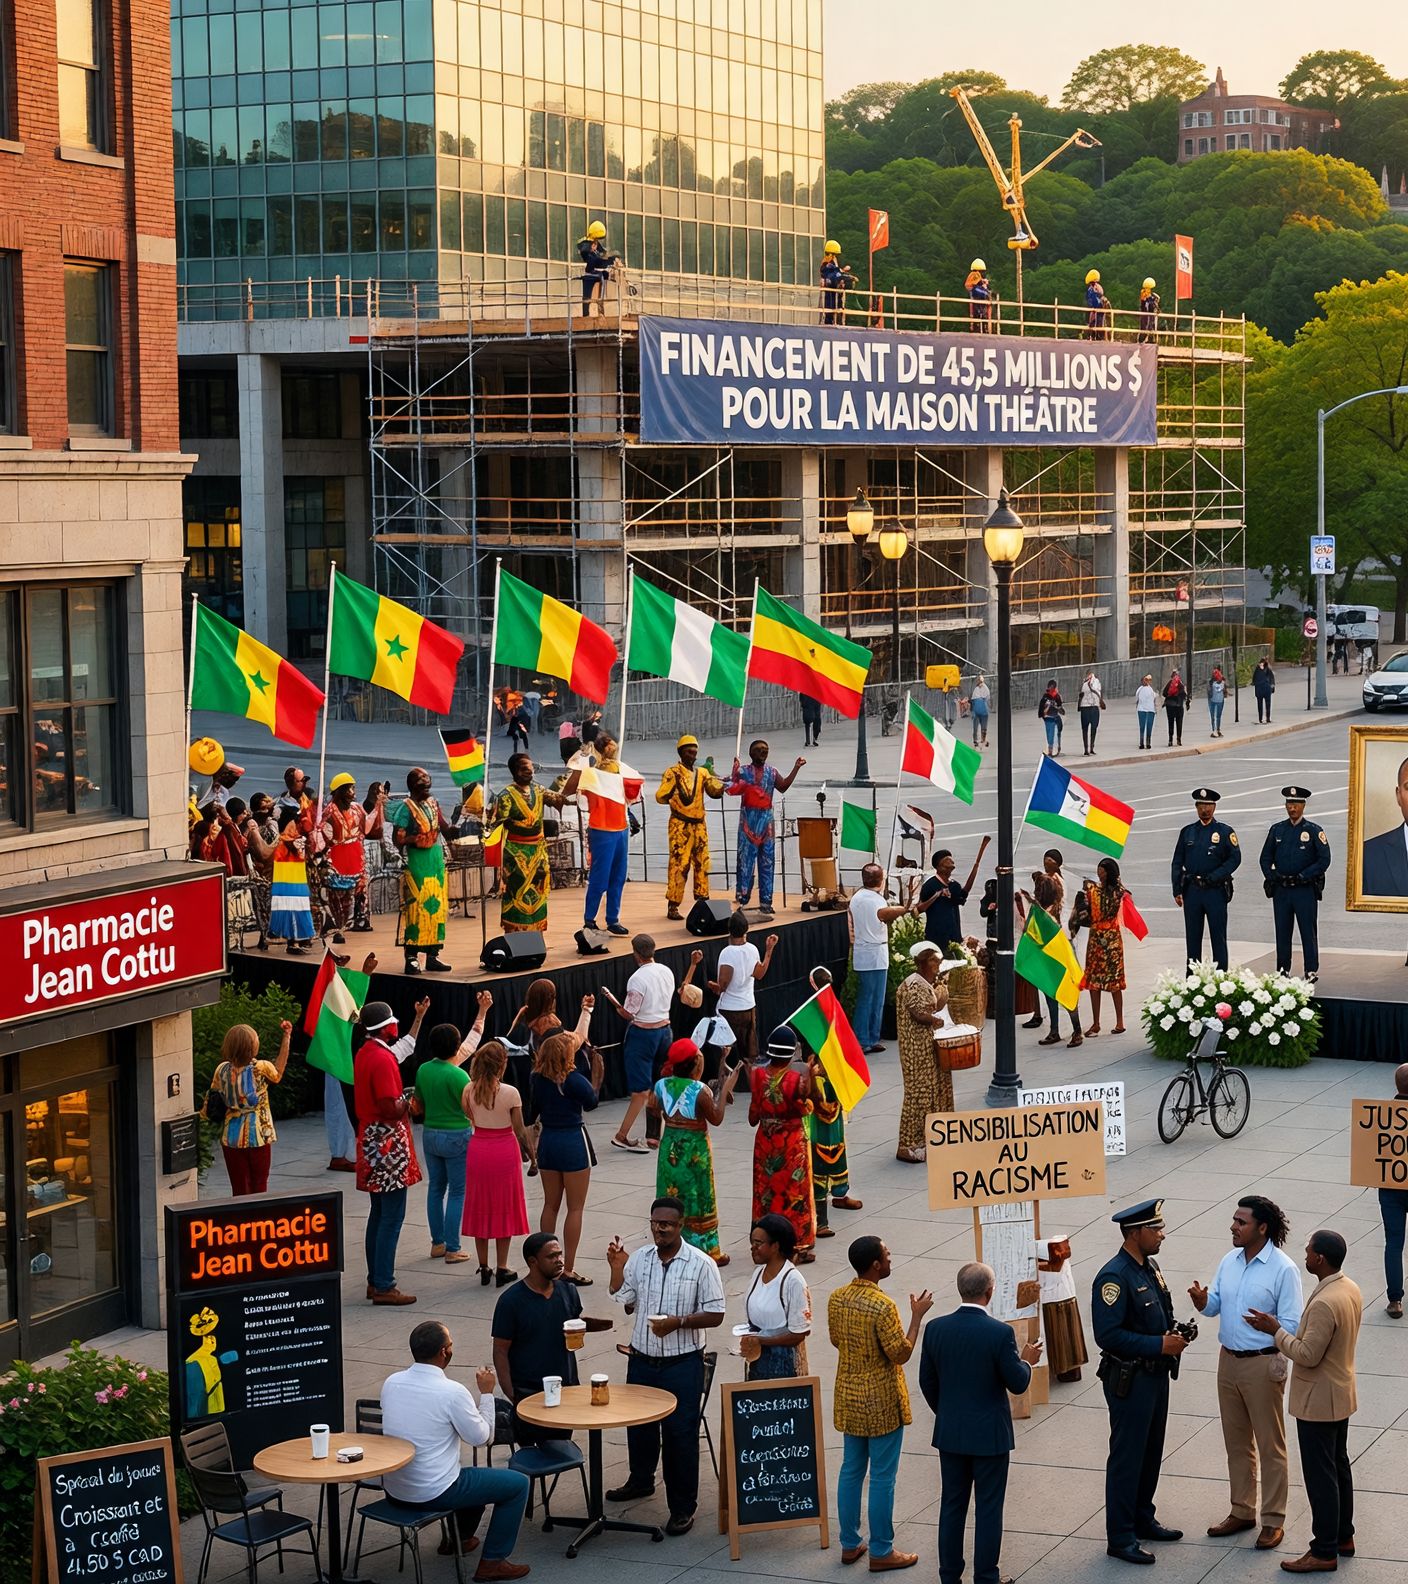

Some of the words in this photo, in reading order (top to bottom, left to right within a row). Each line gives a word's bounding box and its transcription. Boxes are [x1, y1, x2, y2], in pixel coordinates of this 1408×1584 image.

[660, 332, 891, 384] FINANCEMENT
[897, 345, 935, 384] DE
[941, 346, 999, 392] 45,5
[1005, 350, 1120, 392] MILLIONS
[1128, 349, 1143, 397] $
[722, 387, 813, 431] POUR
[819, 392, 859, 431] LA
[866, 392, 980, 432] MAISON
[984, 386, 1098, 433] THÉÂTRE
[23, 896, 175, 960] Pharmacie
[24, 963, 93, 1004] Jean
[101, 942, 176, 986] Cottu
[930, 1108, 1099, 1147] SENSIBILISATION
[998, 1142, 1028, 1164] AU
[953, 1161, 1069, 1200] RACISME
[190, 1208, 327, 1248] Pharmacie
[191, 1251, 252, 1279] Jean
[260, 1240, 329, 1269] Cottu
[144, 1496, 163, 1514] et
[67, 1554, 109, 1575] 4,50
[128, 1545, 163, 1566] CAD
